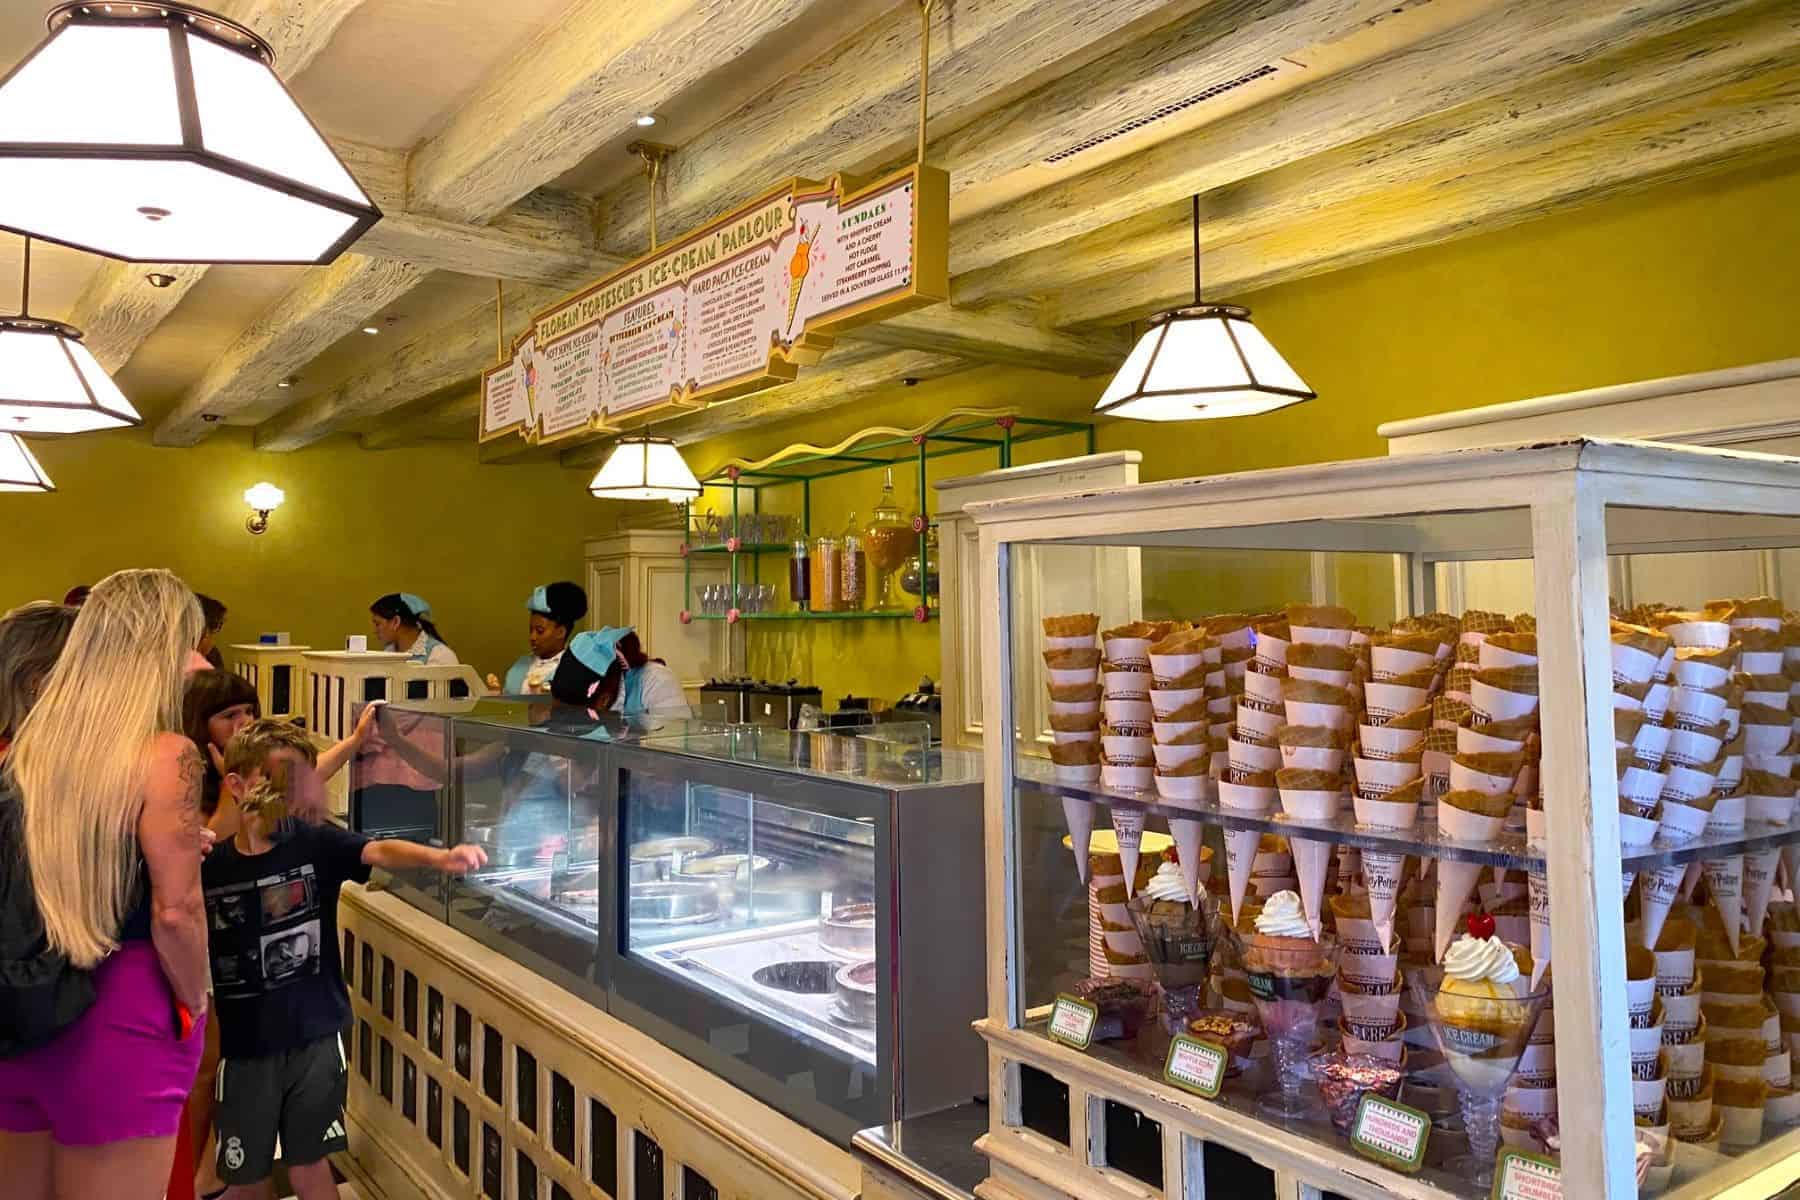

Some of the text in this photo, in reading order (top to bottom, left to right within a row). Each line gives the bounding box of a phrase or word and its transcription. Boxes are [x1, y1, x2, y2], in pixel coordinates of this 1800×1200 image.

[841, 204, 886, 229] SUNDAES
[837, 216, 892, 243] WITH WHIPPED CREAM
[845, 241, 857, 251] AND
[861, 231, 882, 245] CHERRY
[845, 253, 880, 272] HOT CARAMEL
[848, 244, 878, 261] HOT FUDGE
[540, 207, 783, 338] FLOREAN FORTESCUE'S ICE-CREAM PARLOUR
[692, 277, 711, 296] HARD
[712, 269, 731, 288] PACK
[836, 260, 891, 287] STRAWBERRY TOPPING
[821, 290, 839, 303] SERVED
[850, 277, 876, 292] SOUVENIR
[876, 269, 894, 282] GLASS
[624, 300, 656, 326] FEATURES
[1460, 1029, 1495, 1047] CREAM
[1401, 1125, 1417, 1138] AND
